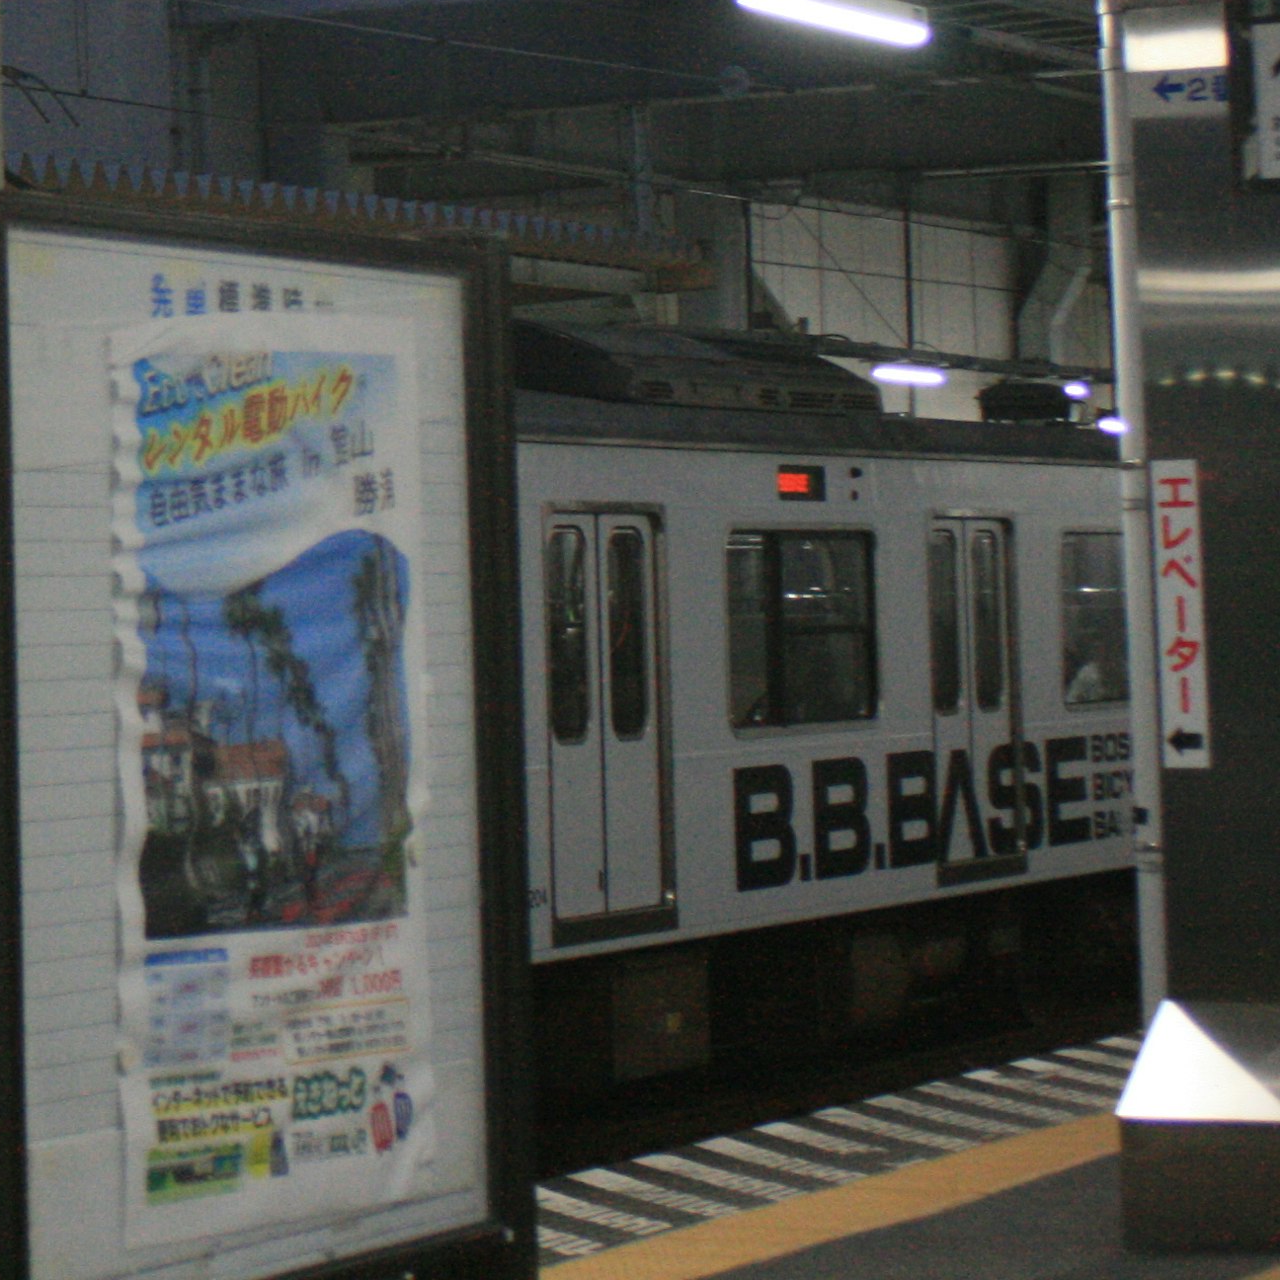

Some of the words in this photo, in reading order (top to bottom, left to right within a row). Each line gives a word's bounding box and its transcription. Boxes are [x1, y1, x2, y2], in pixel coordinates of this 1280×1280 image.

[143, 366, 354, 470] レンタル電動バイク
[1158, 477, 1200, 715] エレベーター
[732, 735, 1087, 892] B.B.BASE
